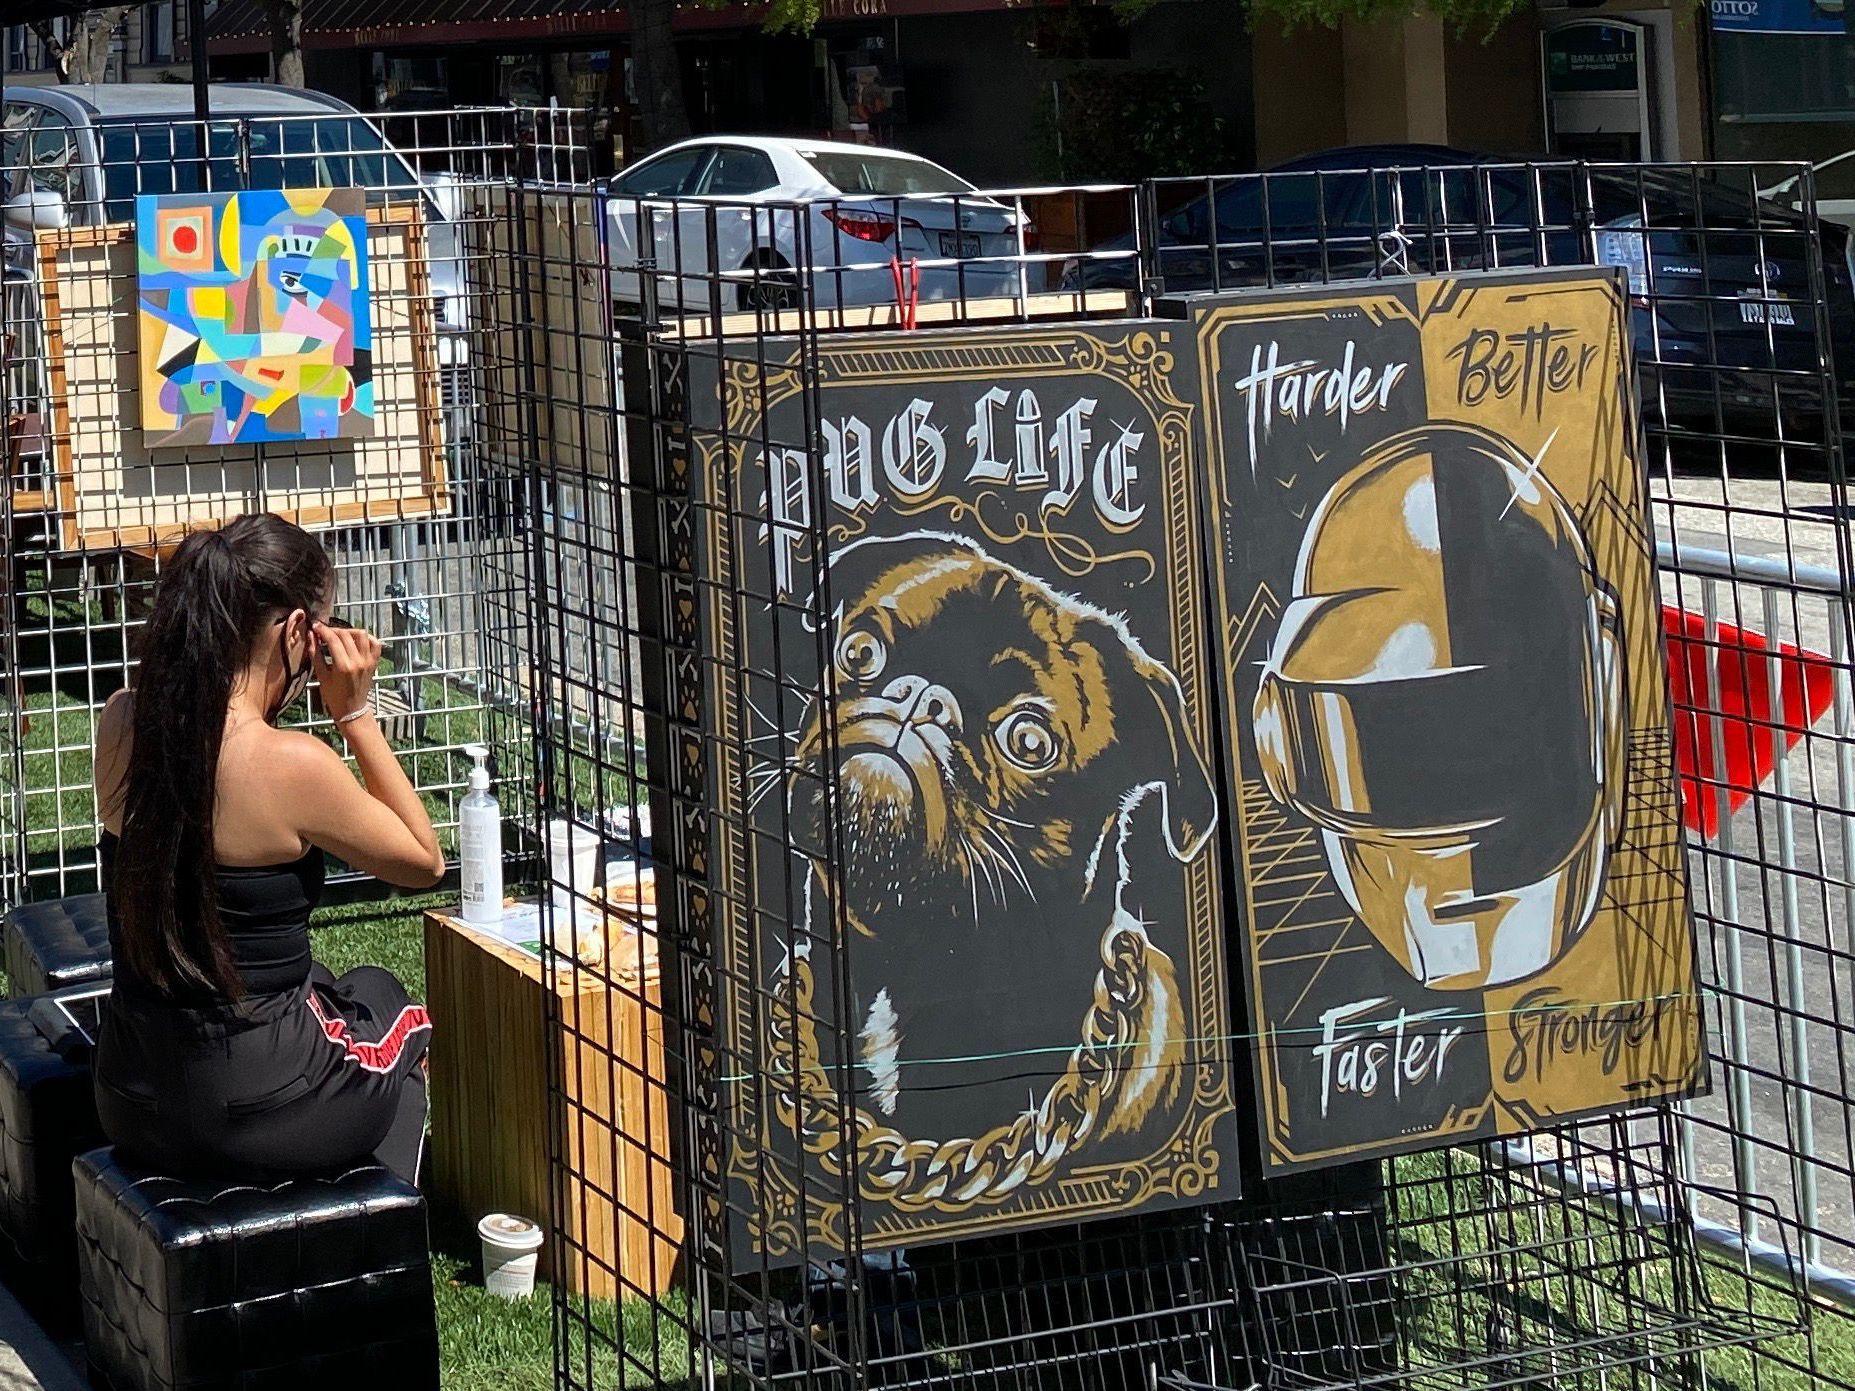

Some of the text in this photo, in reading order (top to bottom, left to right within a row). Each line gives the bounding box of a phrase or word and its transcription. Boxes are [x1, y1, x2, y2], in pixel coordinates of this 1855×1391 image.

[1235, 321, 1600, 490] Harder Better
[1311, 986, 1677, 1119] Faster Stronger
